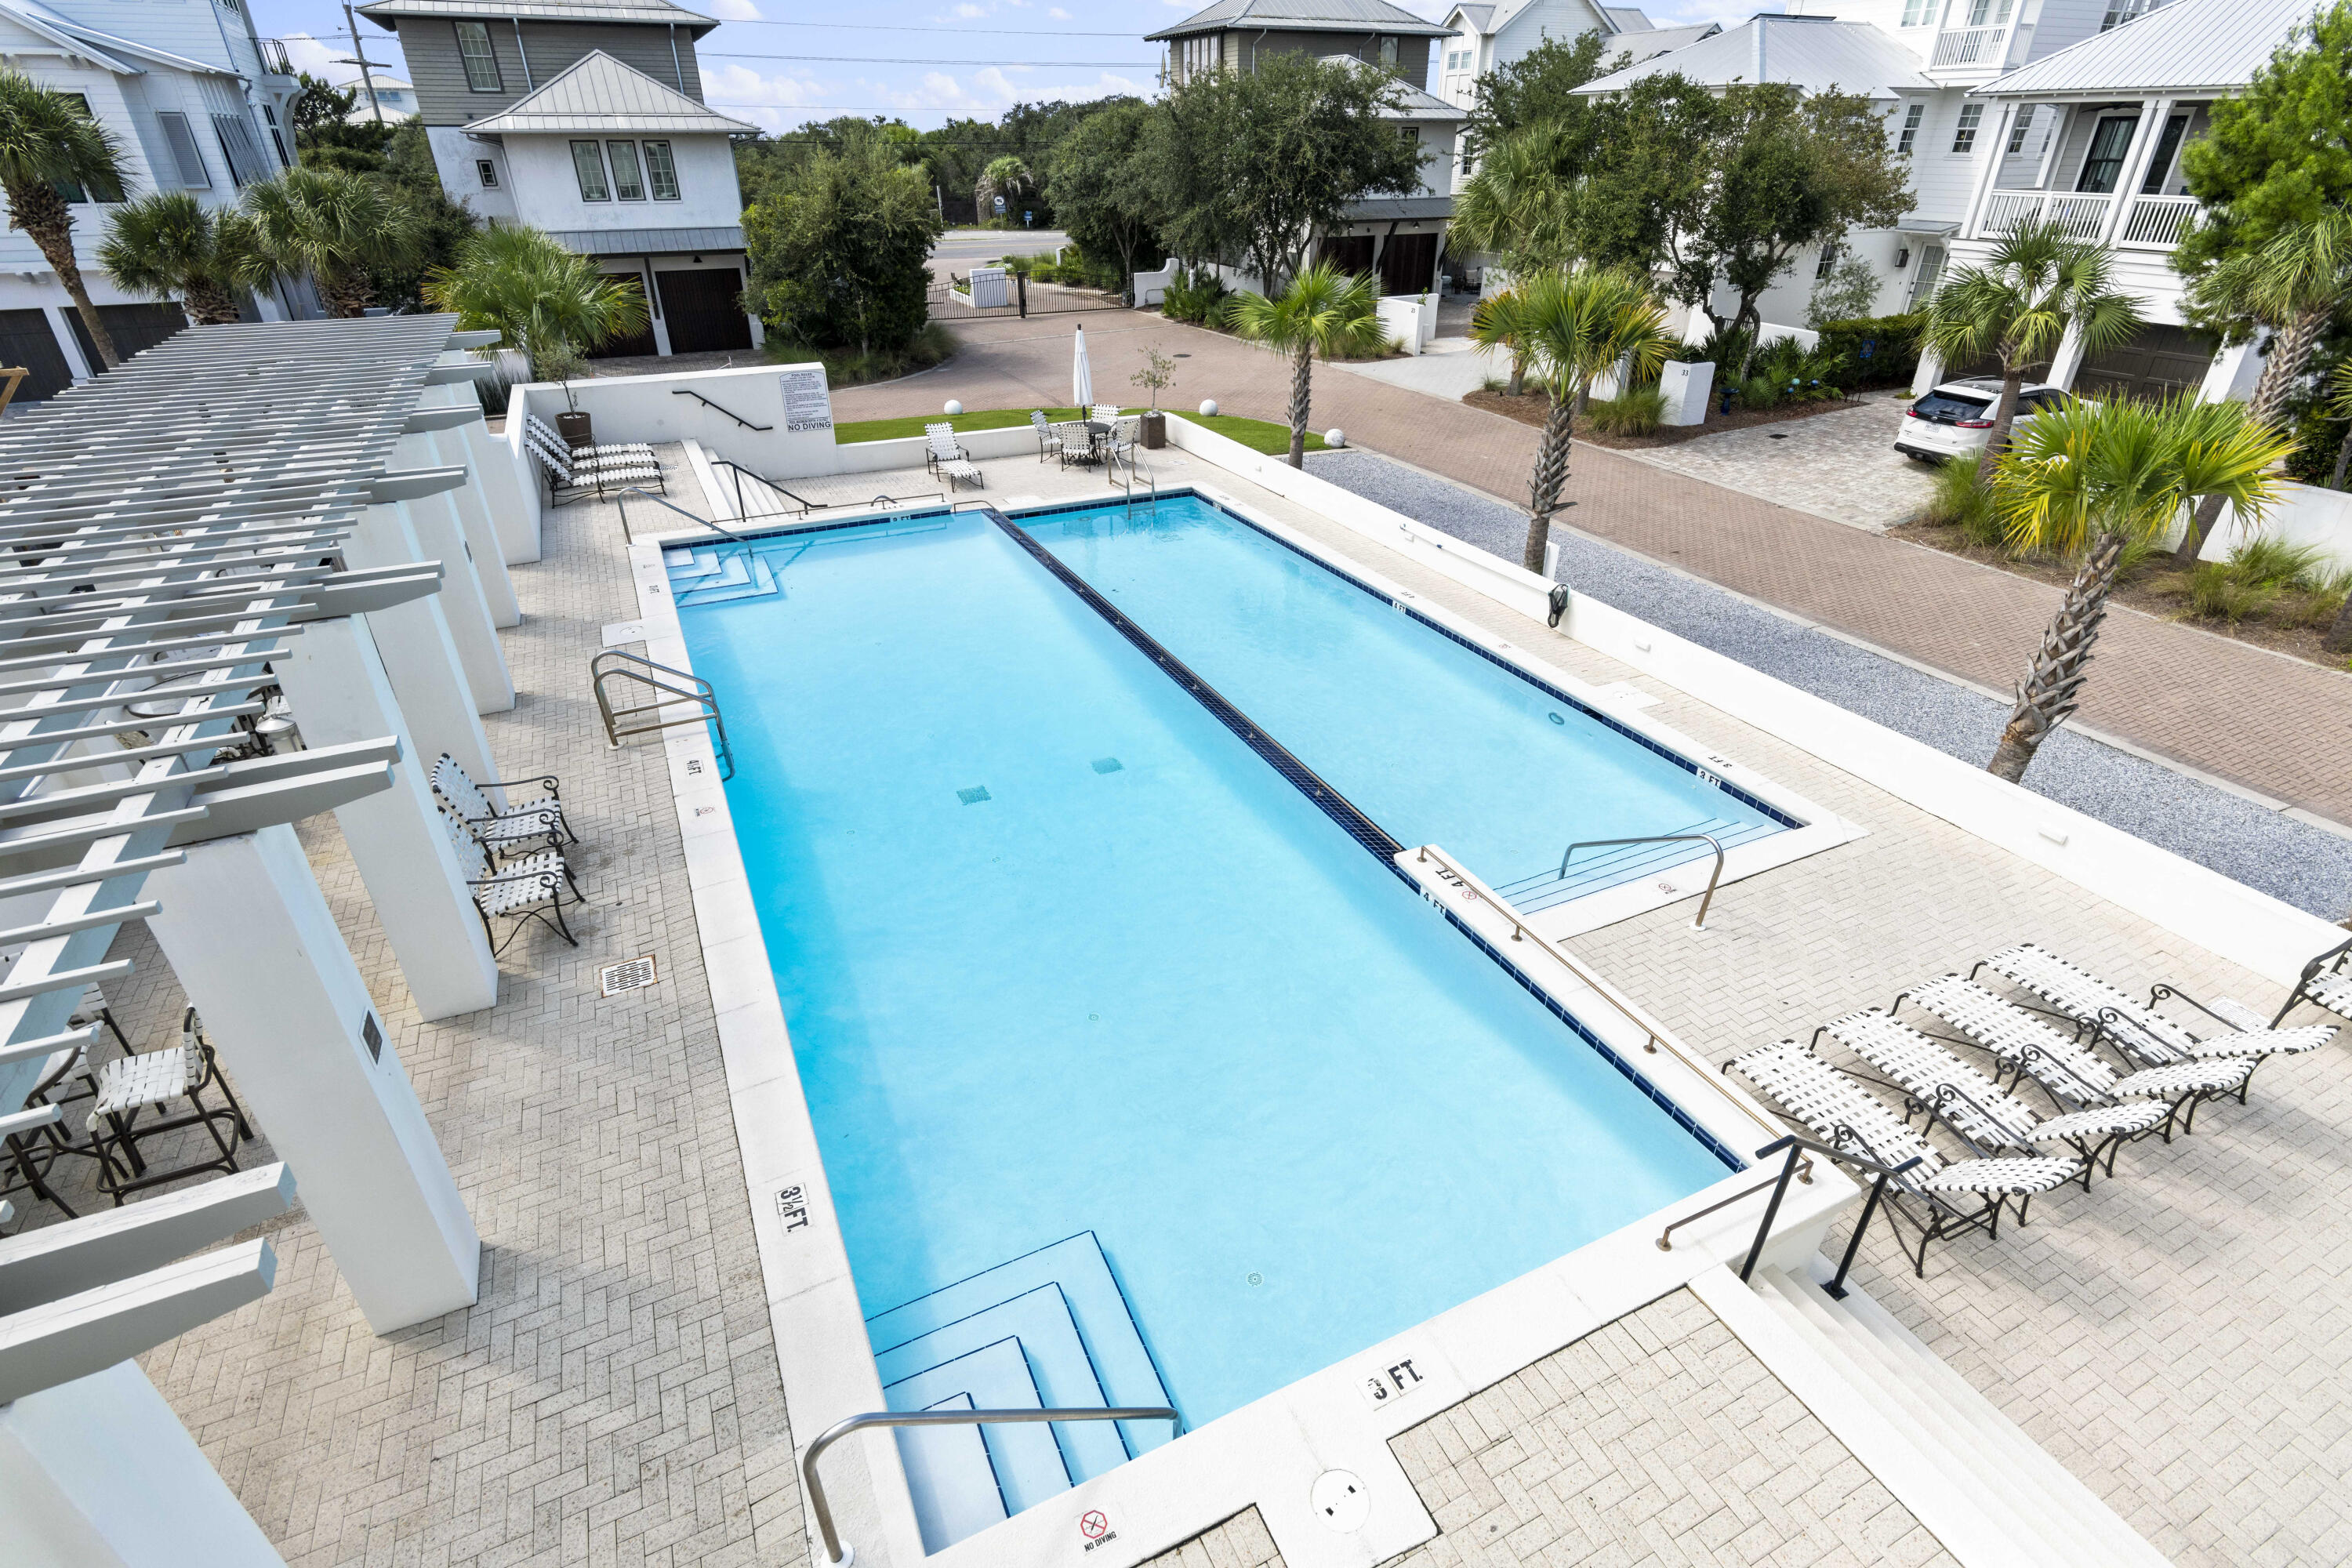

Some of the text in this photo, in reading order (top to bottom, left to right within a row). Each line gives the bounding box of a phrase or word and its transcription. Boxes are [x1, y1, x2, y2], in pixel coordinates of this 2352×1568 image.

[803, 421, 831, 430] DIVING
[1423, 892, 1429, 902] 4
[784, 1207, 808, 1232] FT.
[1388, 1359, 1424, 1390] FT.
[1084, 1531, 1117, 1552] NO DIVING
